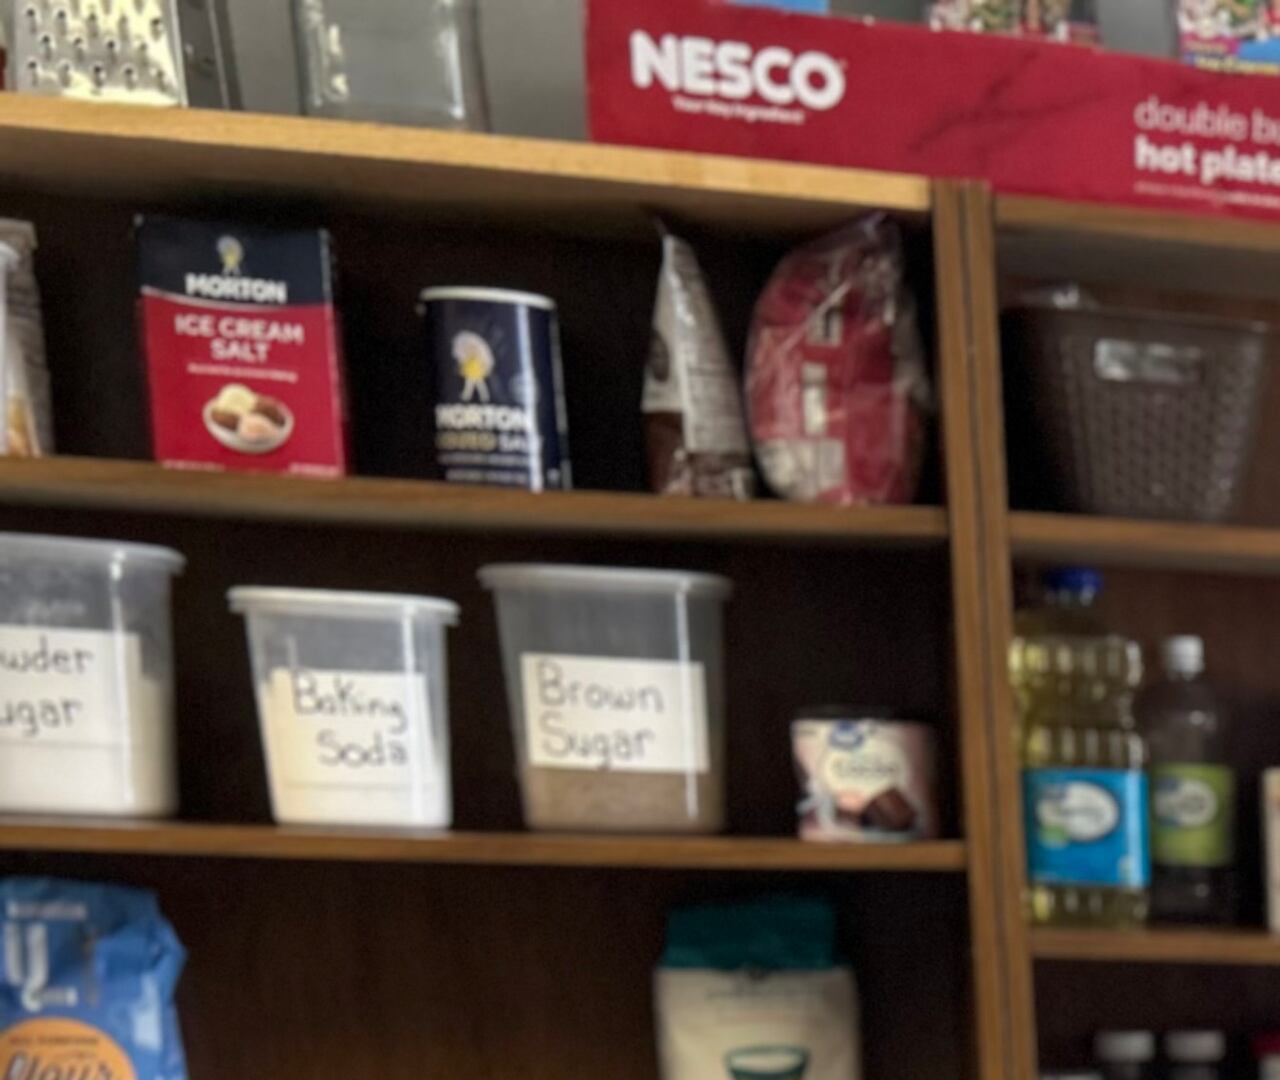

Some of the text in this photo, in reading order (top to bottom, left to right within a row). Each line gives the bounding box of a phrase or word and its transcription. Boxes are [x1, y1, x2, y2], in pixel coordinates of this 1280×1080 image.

[630, 29, 846, 111] NESCO
[1133, 95, 1249, 141] double
[1133, 133, 1197, 174] hot
[185, 272, 288, 304] MORTON
[174, 314, 305, 344] ICE CREAM
[210, 338, 270, 362] SALT
[435, 403, 529, 432] MORTON
[292, 670, 409, 736] Baking
[536, 658, 665, 714] Brown
[316, 728, 409, 769] Soda
[538, 709, 656, 771] Sugar
